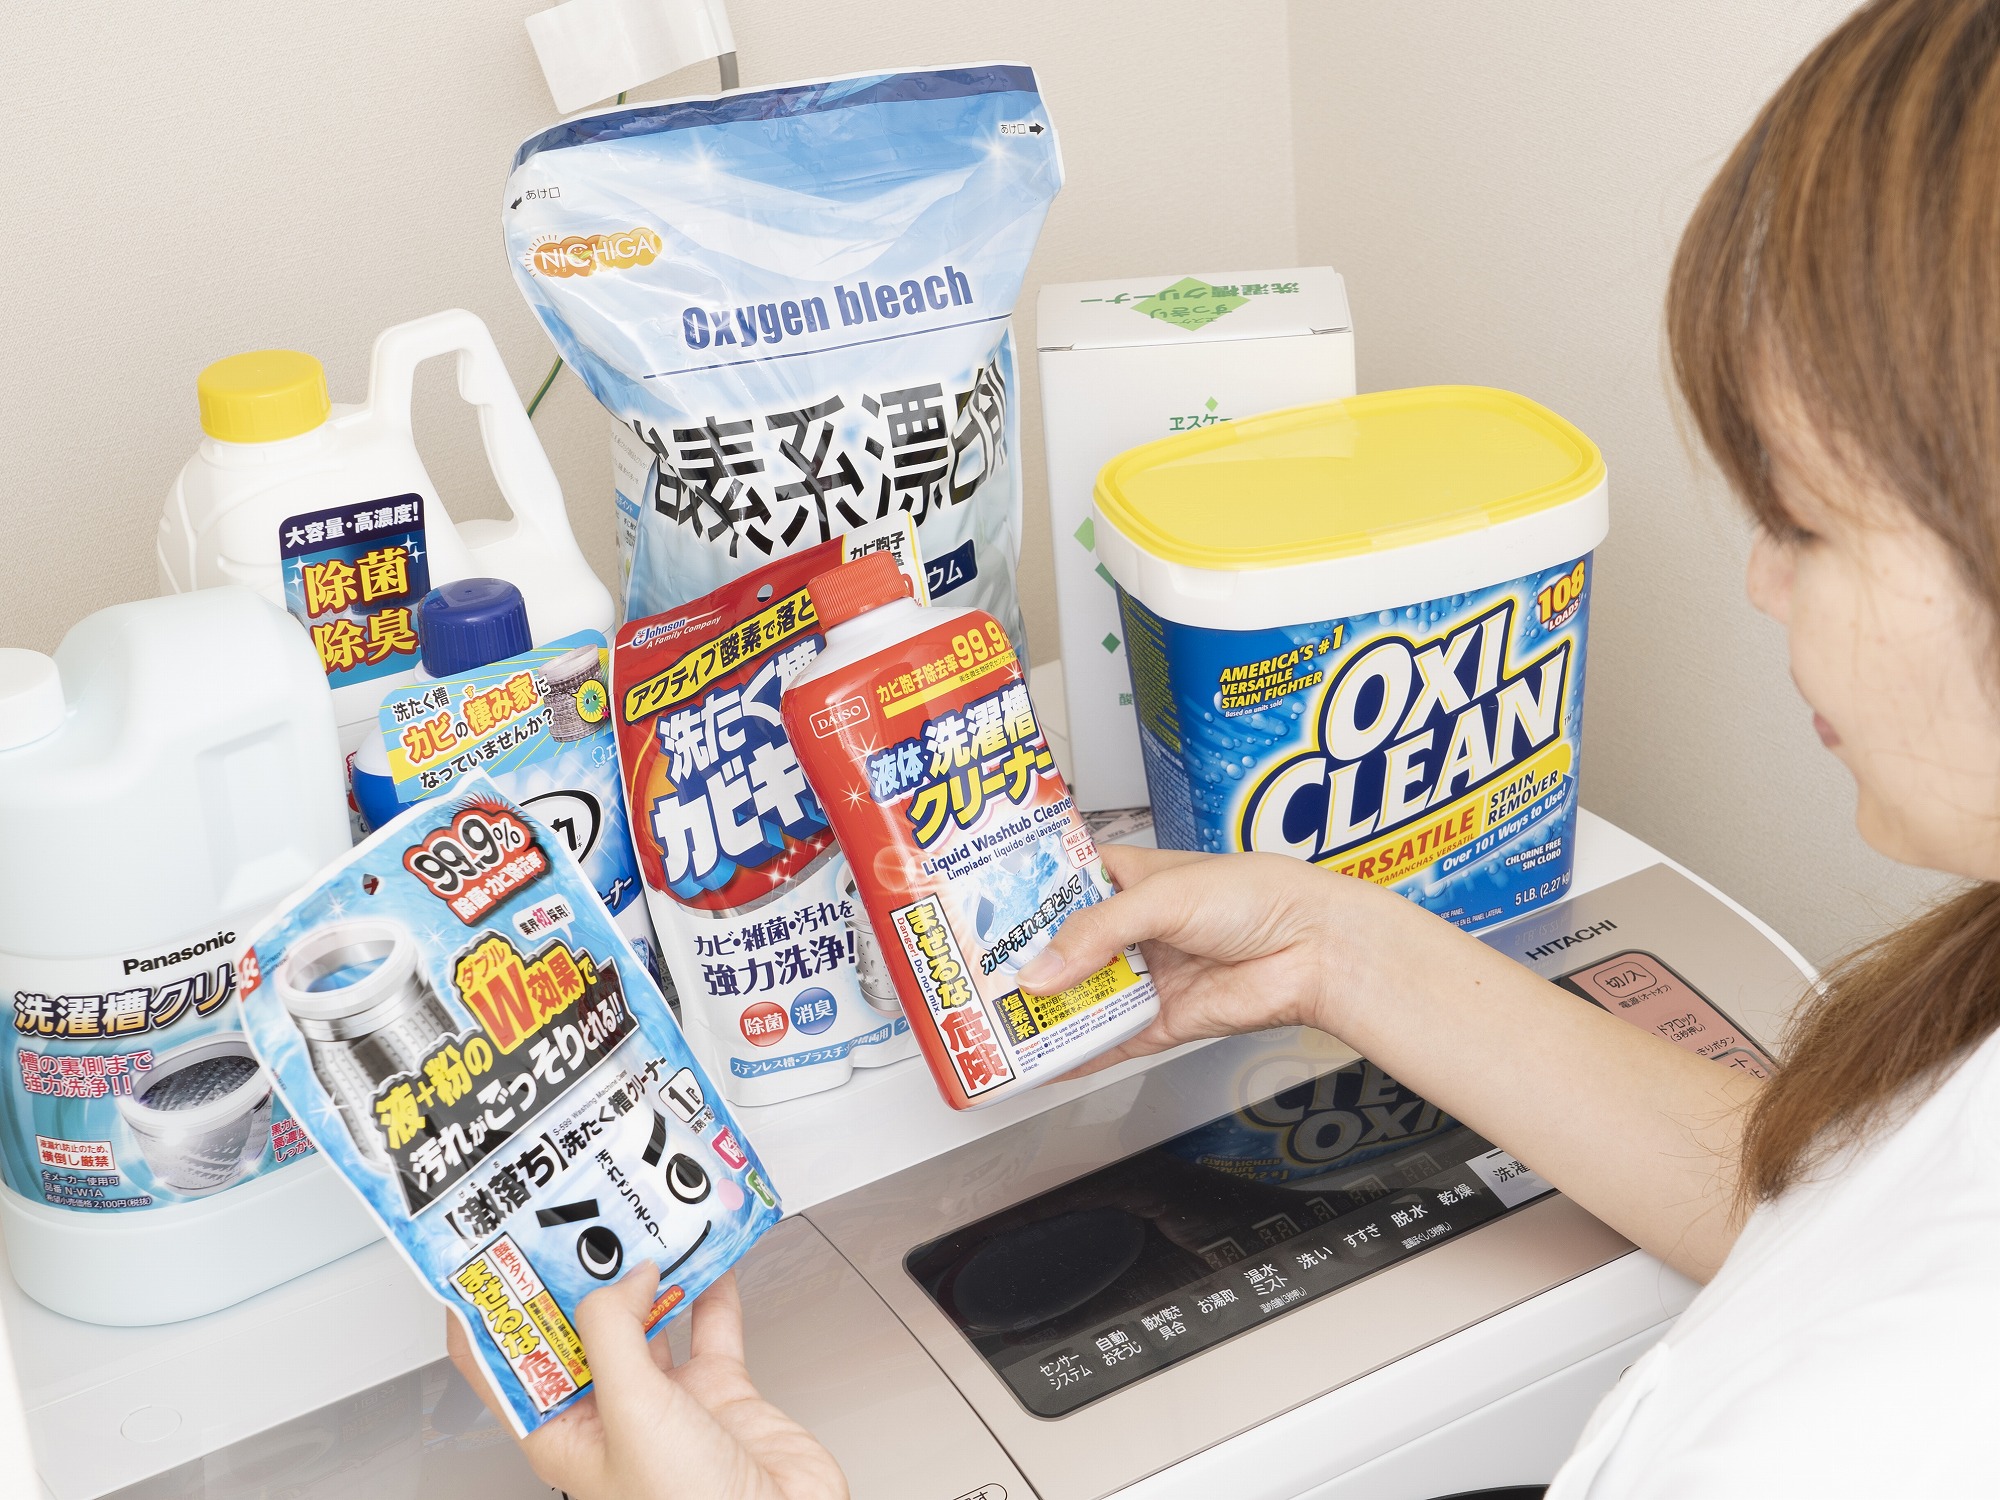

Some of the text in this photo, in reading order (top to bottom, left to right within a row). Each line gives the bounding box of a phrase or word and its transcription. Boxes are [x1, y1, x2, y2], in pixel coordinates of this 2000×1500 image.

[1000, 122, 1027, 135] あけ口
[525, 186, 561, 201] あけ口
[540, 233, 656, 271] NICHIGA
[681, 265, 974, 350] Oxygen bleach
[284, 501, 420, 549] 大容量・高濃度!
[303, 547, 409, 616] 除菌
[1536, 560, 1586, 625] 108
[655, 630, 682, 646] Family
[683, 615, 722, 635] Company
[1548, 598, 1580, 632] LOADS
[312, 608, 418, 673] 除臭
[635, 618, 687, 646] Johnson
[1219, 644, 1314, 683] AMERICA'S
[1221, 667, 1294, 696] VERSATILE
[1221, 671, 1323, 709] STAIN FIGHTER
[1324, 606, 1510, 761] OXI
[392, 685, 451, 723] 洗たく槽
[817, 705, 862, 730] DAISO
[1225, 699, 1283, 718] Based on units sold
[420, 708, 554, 791] なっていませんか?
[870, 683, 1037, 797] 液体 洗濯槽
[1248, 646, 1568, 864] CLEAN
[909, 749, 1053, 845] クリーナー
[1486, 769, 1560, 827] REMOVER
[1490, 769, 1536, 809] STAIN
[653, 741, 808, 883] カビキ
[1442, 782, 1567, 872] Over 101 Ways to Use!
[924, 796, 1074, 876] Liquid Washtub Cleaner
[946, 853, 993, 881] Limpiador
[993, 836, 1025, 859] líquido
[1025, 831, 1037, 845] de
[1036, 816, 1072, 839] lavadoras
[1335, 805, 1476, 880] ERSATILE
[1435, 833, 1475, 858] VERSATIL
[1505, 837, 1563, 867] CHLORINE FREE
[413, 814, 526, 895] 99.9%
[1522, 848, 1563, 871] SIN CLORO
[1515, 892, 1522, 907] 5
[1523, 887, 1538, 903] LB.
[1539, 876, 1562, 900] (2.27
[693, 899, 856, 957] カビ・雑菌・汚れを
[980, 873, 1083, 976] カビ・汚れを落として
[1525, 919, 1618, 961] HITACHI
[123, 929, 237, 976] Panasonic
[460, 943, 506, 990] ダブル
[700, 930, 857, 997] 強力洗浄!
[896, 916, 940, 1017] Danger! Do not mix.
[1605, 969, 1647, 989] 切/入
[743, 1012, 785, 1037] 除菌
[794, 998, 834, 1026] 消臭
[1002, 992, 1036, 1041] 塩素系
[1656, 1013, 1698, 1036] ドアロック
[19, 1050, 153, 1077] 槽の裏側まで
[24, 1074, 133, 1098] 強力洗浄!!
[41, 1150, 110, 1168] 横倒し厳禁
[41, 1169, 121, 1187] 全メーカー使用可
[44, 1181, 105, 1199] 品番 N-W1A
[1436, 1183, 1476, 1207] 乾燥
[1390, 1203, 1429, 1229] 脱水
[1343, 1222, 1383, 1249] すすぎ
[491, 1240, 536, 1297] 酸性タイプ
[1296, 1245, 1335, 1271] 洗い
[1243, 1263, 1279, 1286] 温水
[1252, 1274, 1289, 1298] ミスト
[1196, 1287, 1239, 1315] お湯取
[1095, 1330, 1130, 1352] 自動
[1158, 1319, 1188, 1341] 具合
[1039, 1353, 1081, 1378] センサー
[1102, 1341, 1143, 1367] おそうじ
[1049, 1364, 1093, 1391] システム
